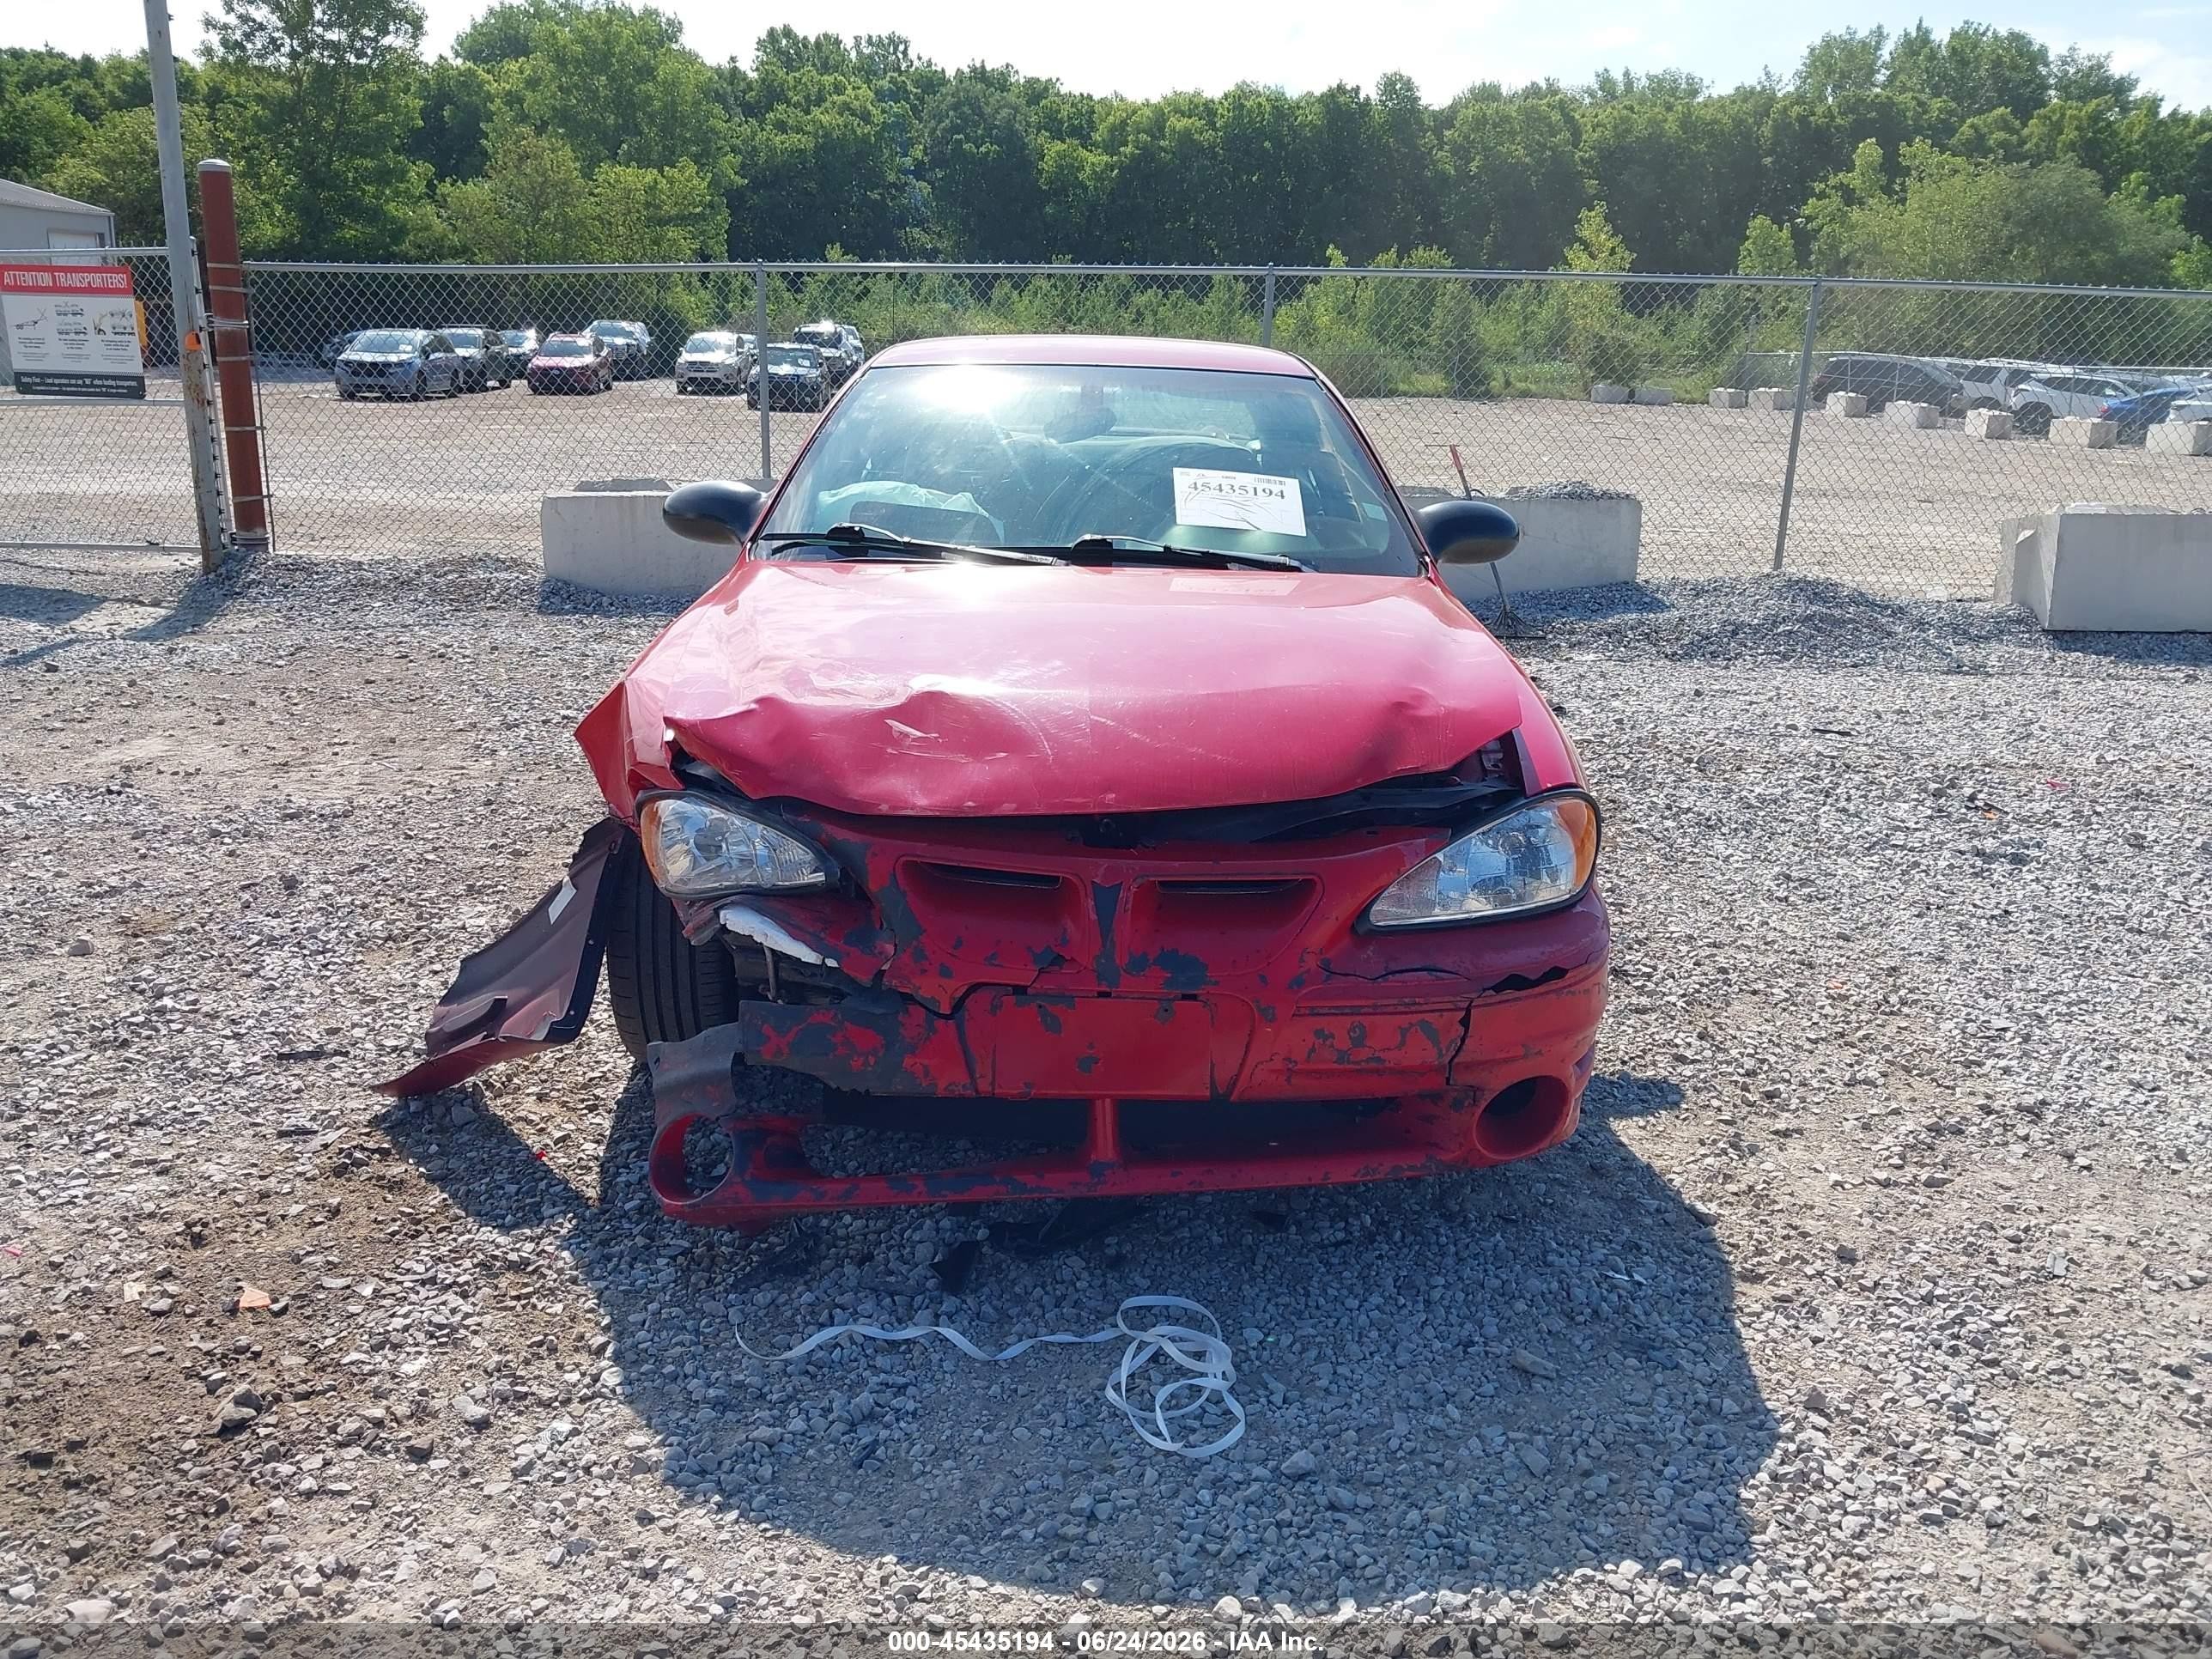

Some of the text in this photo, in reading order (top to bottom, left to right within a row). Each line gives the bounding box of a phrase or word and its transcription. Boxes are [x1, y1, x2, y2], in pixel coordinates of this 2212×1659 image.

[4, 271, 128, 289] ATTENTION TRANSPORTERS!
[1188, 481, 1286, 500] 45435194
